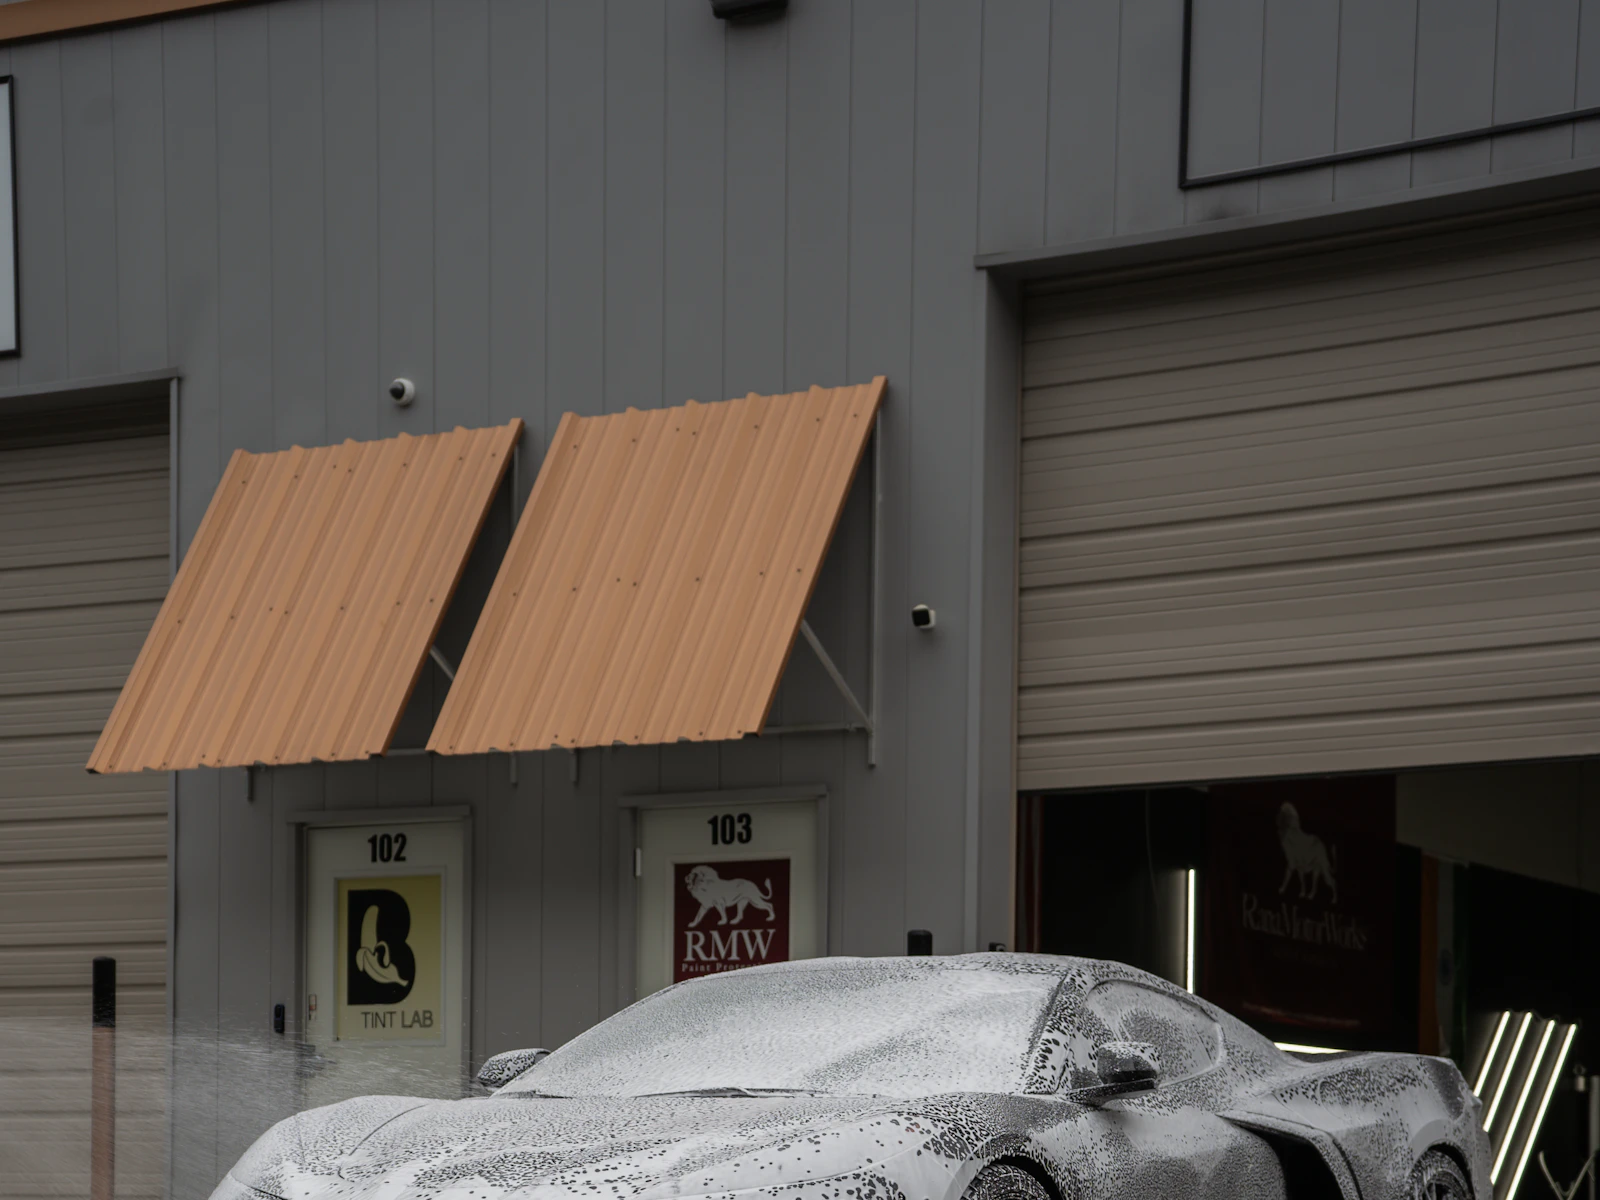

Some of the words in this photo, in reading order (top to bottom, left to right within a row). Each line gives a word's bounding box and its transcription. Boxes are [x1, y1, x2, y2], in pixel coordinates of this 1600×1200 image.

[707, 813, 752, 845] 103
[367, 832, 407, 863] 102
[683, 929, 776, 962] RMW
[681, 962, 711, 973] Paint
[361, 1011, 396, 1029] TINT
[401, 1010, 434, 1028] LAB
